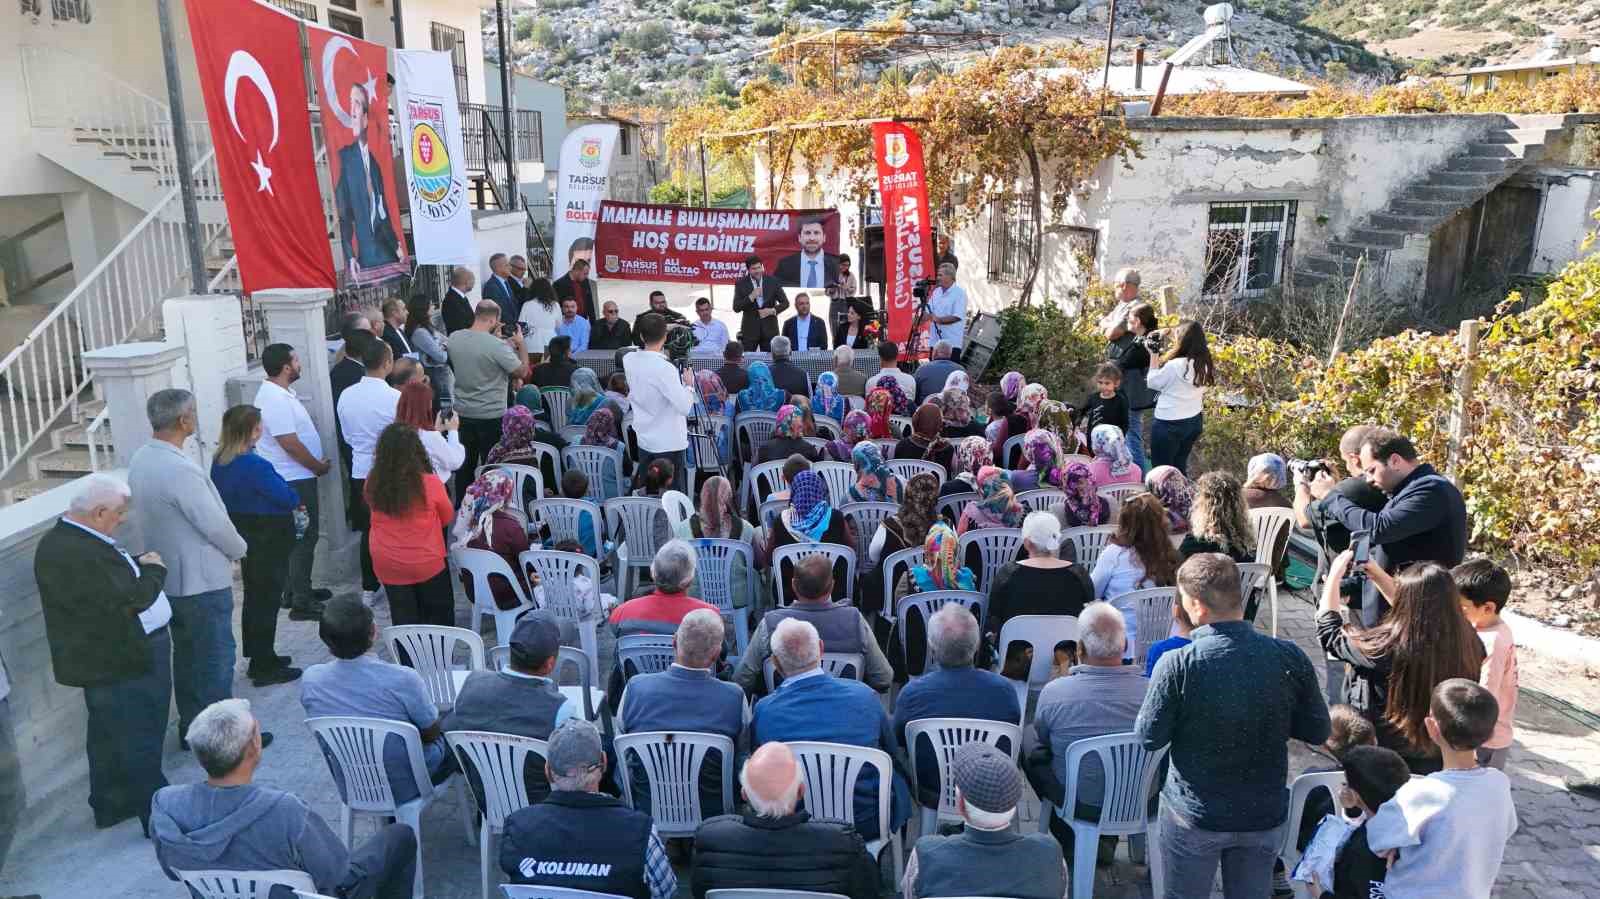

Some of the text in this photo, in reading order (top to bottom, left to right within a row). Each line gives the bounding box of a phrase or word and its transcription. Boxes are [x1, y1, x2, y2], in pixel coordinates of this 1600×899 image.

[566, 210, 599, 221] BOLTA
[601, 206, 789, 233] MAHALLE BULUŞMAMIZA
[632, 231, 757, 254] HOŞ GELDİNİZ
[620, 260, 657, 270] TARSUS
[702, 260, 747, 271] TARSUS
[536, 861, 612, 877] KOLUMAN
